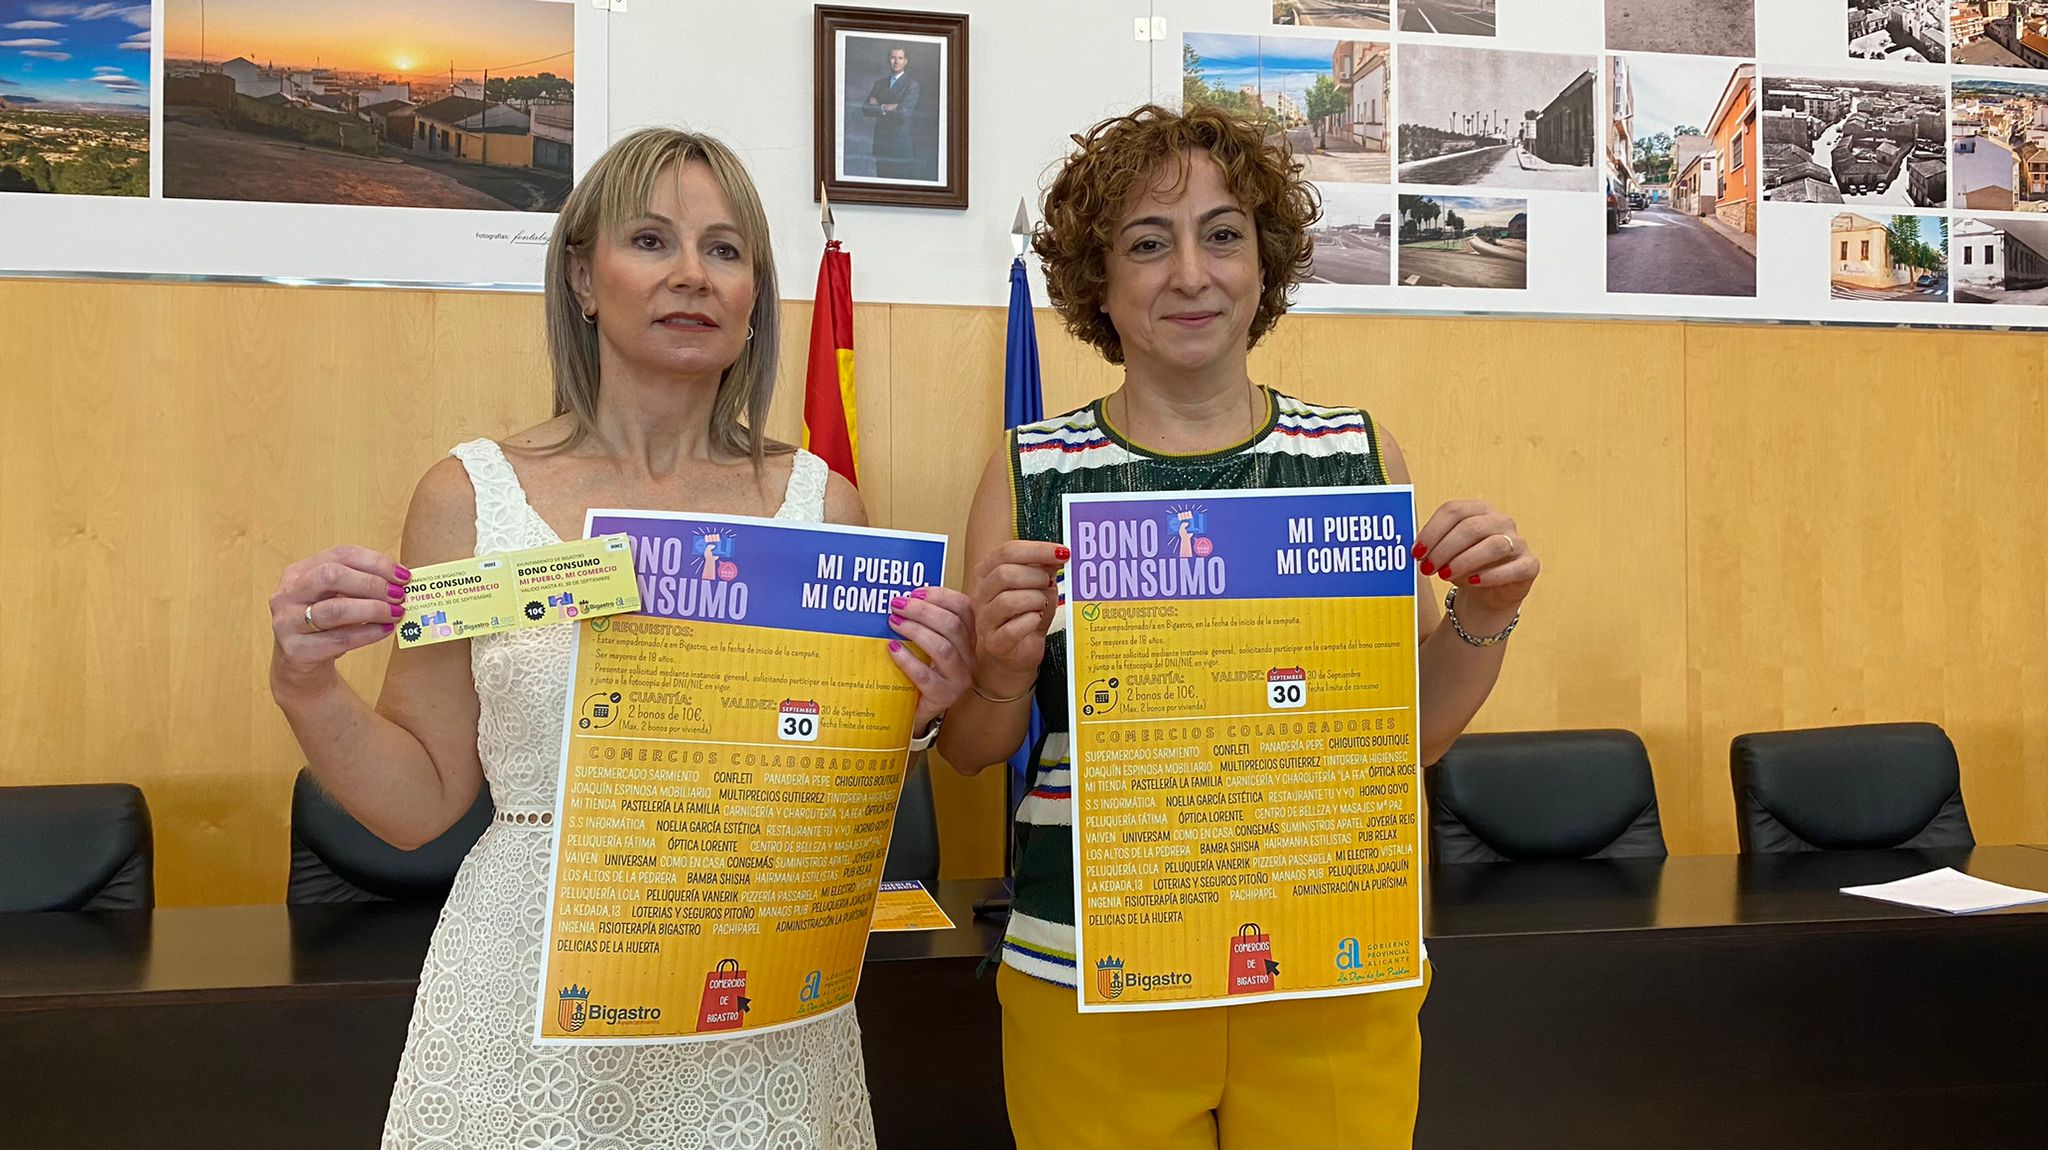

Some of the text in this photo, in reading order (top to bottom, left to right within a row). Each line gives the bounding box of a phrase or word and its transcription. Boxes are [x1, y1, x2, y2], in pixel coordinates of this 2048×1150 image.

[1288, 515, 1401, 544] MI PUEBLO,
[1078, 519, 1158, 560] BONO
[518, 558, 600, 576] BONO CONSUMO
[818, 554, 843, 580] MI
[1277, 545, 1406, 575] MI COMERCIO
[532, 574, 563, 584] PUEBLO,
[577, 566, 617, 576] COMERCIO
[580, 575, 610, 584] SEPTIEMBRE
[1079, 557, 1225, 599] CONSUMO
[404, 575, 482, 593] ONO CONSUMO
[411, 592, 444, 601] PUEBLO,
[458, 583, 499, 595] COMERCIO
[802, 583, 828, 609] MI
[590, 602, 614, 610] Bigastro
[1102, 606, 1178, 620] REQUISITOS:
[612, 621, 693, 637] REQUISITOS:
[1090, 624, 1106, 632] Estar
[1204, 618, 1210, 627] la
[1211, 618, 1229, 627] fecha
[1230, 616, 1238, 626] de
[1257, 616, 1264, 625] de
[1265, 615, 1271, 625] la
[403, 627, 419, 636] 10€
[1090, 637, 1101, 647] Ser
[1103, 640, 1128, 649] mayores
[1130, 636, 1137, 644] de
[1139, 635, 1146, 643] 18
[1126, 671, 1185, 686] CUANTÍA:
[1211, 669, 1265, 682] VALIDEZ:
[1308, 669, 1361, 681] 30 de Septiembre
[629, 691, 693, 705] CUANTÍA:
[1127, 685, 1199, 700] 2 bonos de 10€.
[1273, 685, 1301, 703] 30
[628, 705, 704, 722] 2 bonos de 10€.
[782, 706, 816, 714] SEPTEMBER
[784, 717, 813, 736] 30
[1096, 718, 1396, 743] COMERCIOS COLABORADORES
[1260, 739, 1324, 752] PANADERÍA PEPE
[1329, 734, 1409, 749] CHIGUITOS BOUTIQUE
[1085, 746, 1199, 762] SUPERMERCADO SARMIENTO
[1213, 744, 1249, 756] CONFLETI
[590, 746, 896, 771] COMERCIOS COLABORADORES
[1220, 757, 1320, 772] MULTIPRECIOS GUTIERREZ
[714, 772, 752, 784] CONFLETI
[1369, 765, 1396, 778] ÓPTICA
[1131, 776, 1223, 791] PASTELERÍA LA FAMILIA
[1360, 783, 1408, 797] HORNO GOYO
[719, 789, 825, 804] MULTIPRECIOS GUTIERREZ
[1166, 790, 1263, 807] NOELIA GARCÍA ESTÉTICA
[621, 800, 720, 814] PASTELERÍA LA FAMILIA
[1086, 813, 1167, 827] PELUQUERÍA FÁTIMA
[1178, 810, 1244, 825] ÓPTICA LORENTE
[1366, 813, 1415, 828] JOYERÍA REIG
[1123, 831, 1171, 843] UNIVERSAM
[1235, 824, 1279, 836] CONGEMÁS
[1358, 829, 1397, 842] PUB RELAX
[1200, 841, 1259, 854] BAMBA SHISHA
[1336, 848, 1379, 861] MI ELECTRO
[1165, 859, 1250, 873] PELUQUERÍA VANERIK
[1329, 860, 1409, 877] PELUQUERIA JOAQUÍN
[1153, 871, 1268, 890] LOTERIAS Y SEGUROS PITOÑO
[1293, 876, 1407, 897] ADMINISTRACIÓN LA PURÍSIMA
[647, 889, 739, 902] PELUQUERÍA VANERIK
[1125, 892, 1219, 907] FISIOTERAPÍA BIGASTRO
[1089, 911, 1183, 926] DELICIAS DE LA HUERTA
[599, 921, 701, 935] FISIOTERAPÍA BIGASTRO
[557, 939, 660, 953] DELICIAS DE LA HUERTA
[1234, 941, 1270, 953] COMERCIOS
[1368, 940, 1410, 950] GOBIERNO
[1368, 949, 1409, 958] PROVINCIAL
[1247, 959, 1256, 968] DE
[1368, 957, 1409, 966] ALICANTE
[709, 978, 746, 989] COMERCIOS
[1125, 971, 1192, 991] Bigastro
[1237, 974, 1268, 986] BIGASTRO
[719, 996, 728, 1006] DE
[589, 1005, 661, 1025] Bigastro
[706, 1012, 739, 1023] BIGASTRO
